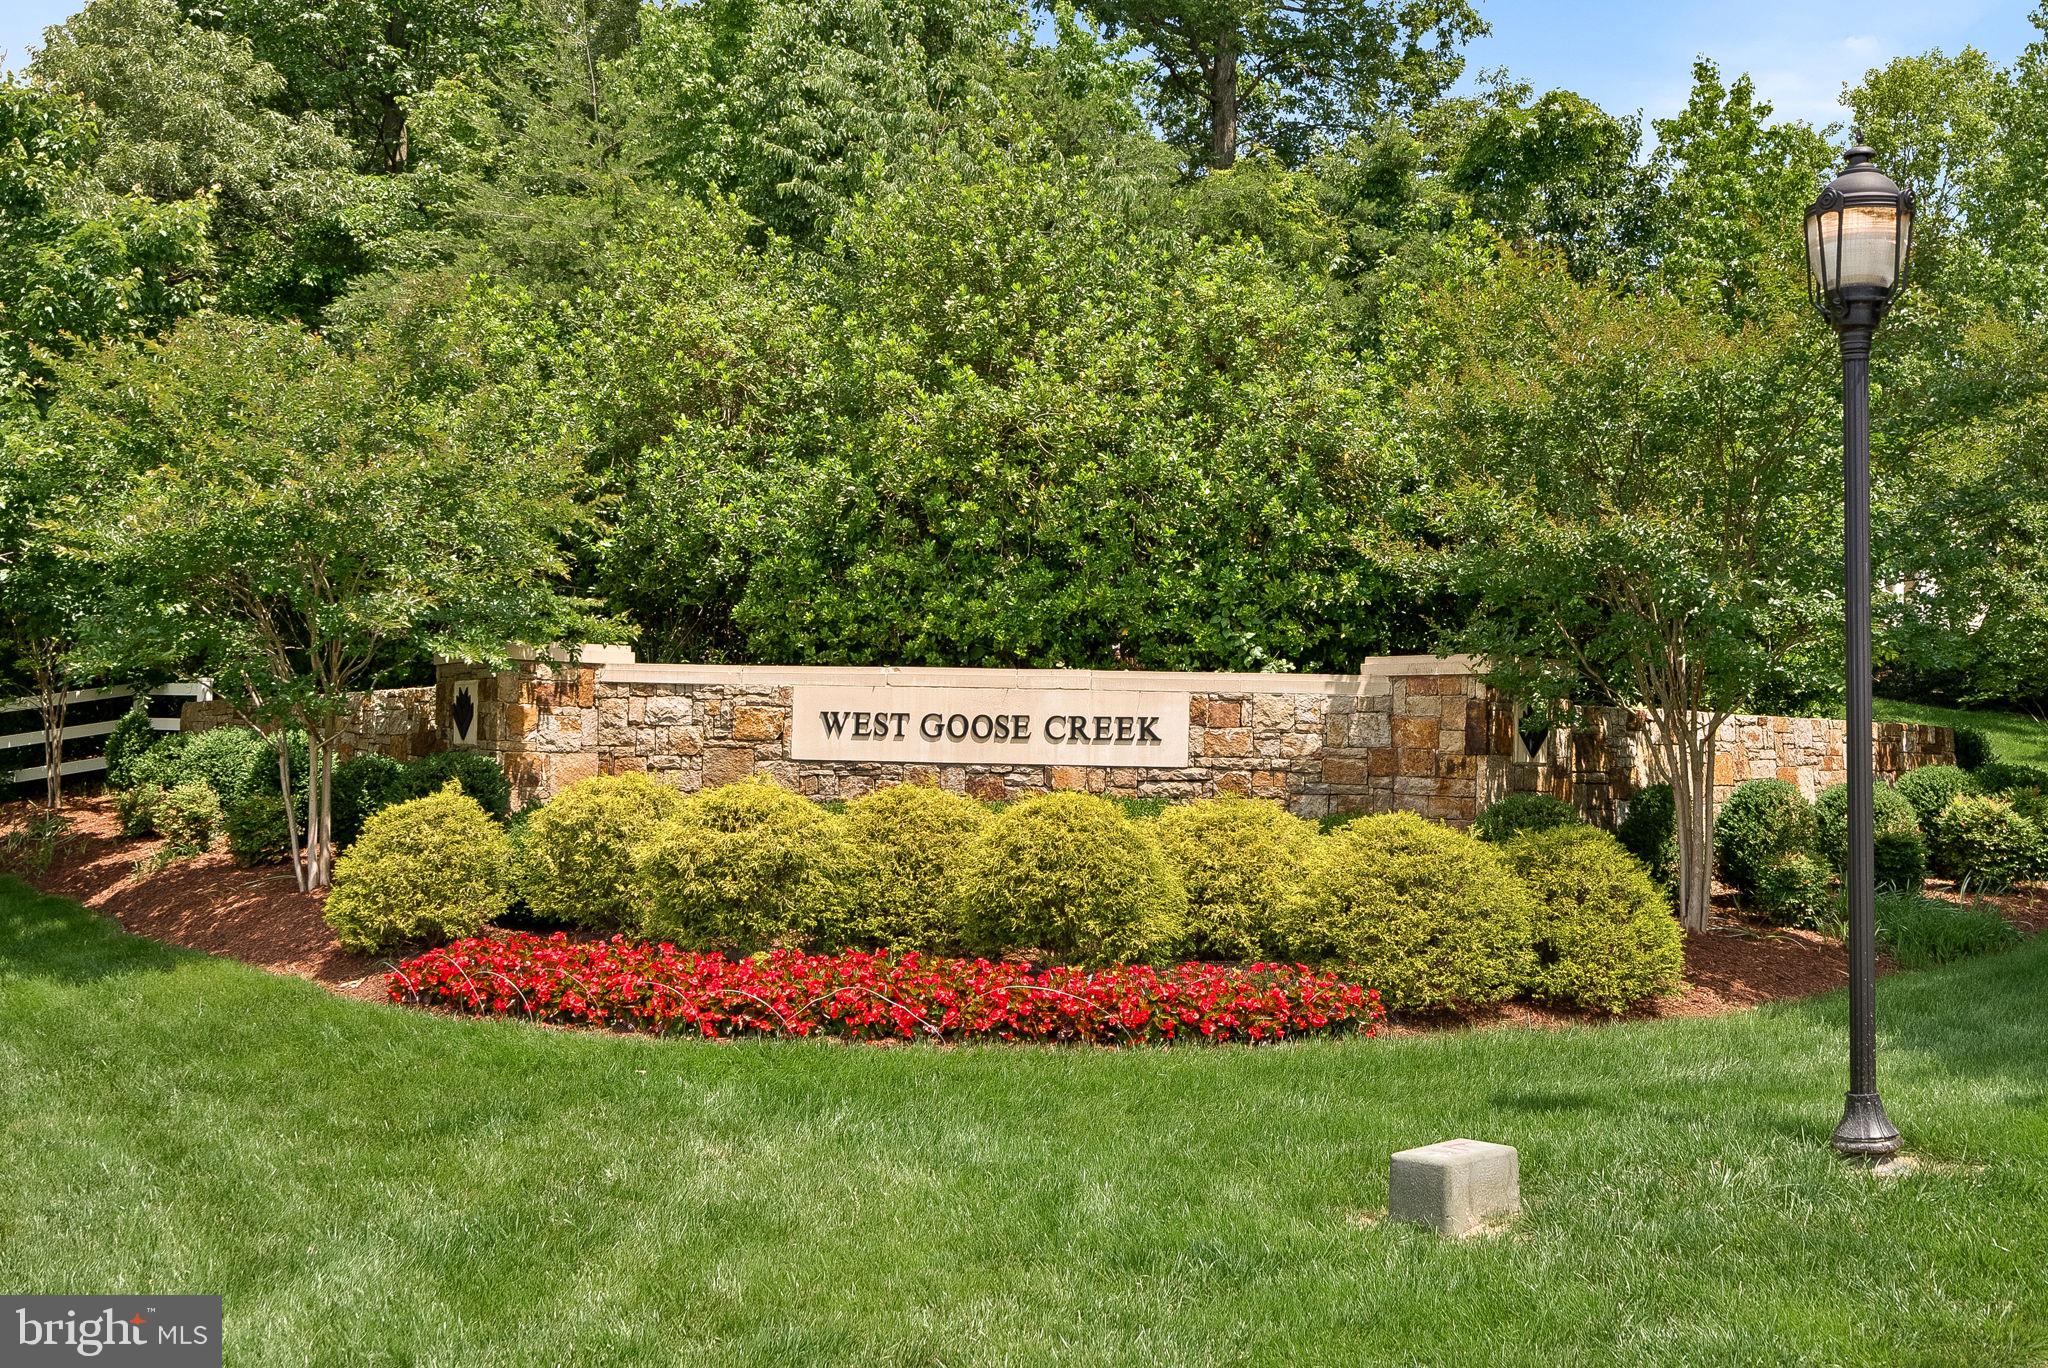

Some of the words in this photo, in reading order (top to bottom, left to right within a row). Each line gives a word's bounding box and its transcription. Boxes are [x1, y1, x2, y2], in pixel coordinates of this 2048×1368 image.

[819, 711, 910, 740] WEST
[920, 713, 1032, 742] GOOSE
[1044, 715, 1162, 744] CREEK
